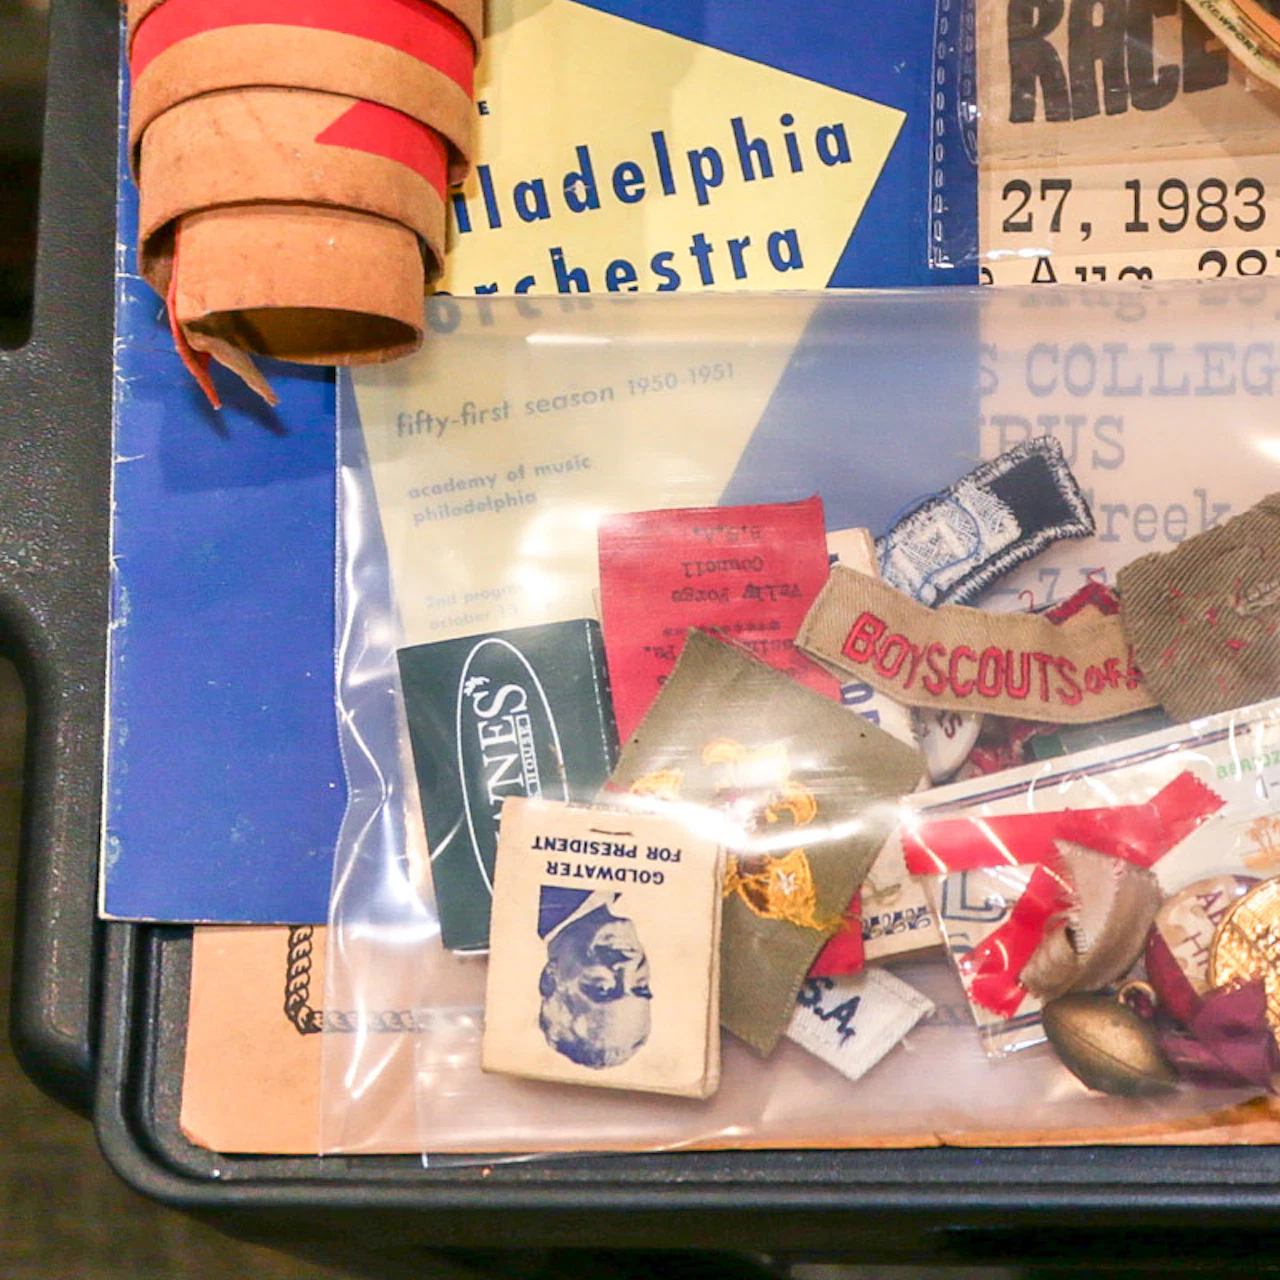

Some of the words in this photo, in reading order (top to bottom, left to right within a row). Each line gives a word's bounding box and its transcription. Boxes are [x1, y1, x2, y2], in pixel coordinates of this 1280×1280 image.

[451, 113, 852, 233] iladelphia
[1001, 178, 1093, 243] 27,
[1124, 177, 1266, 234] 1983
[396, 401, 510, 438] fifty-first
[525, 384, 615, 415] season
[408, 472, 497, 501] academy
[507, 464, 526, 483] of
[534, 454, 591, 478] music
[412, 489, 538, 528] philadelphia
[1092, 487, 1232, 543] reek
[532, 836, 637, 859] PRESIDENT
[646, 849, 682, 863] FOR
[546, 861, 665, 885] GOLDWATER
